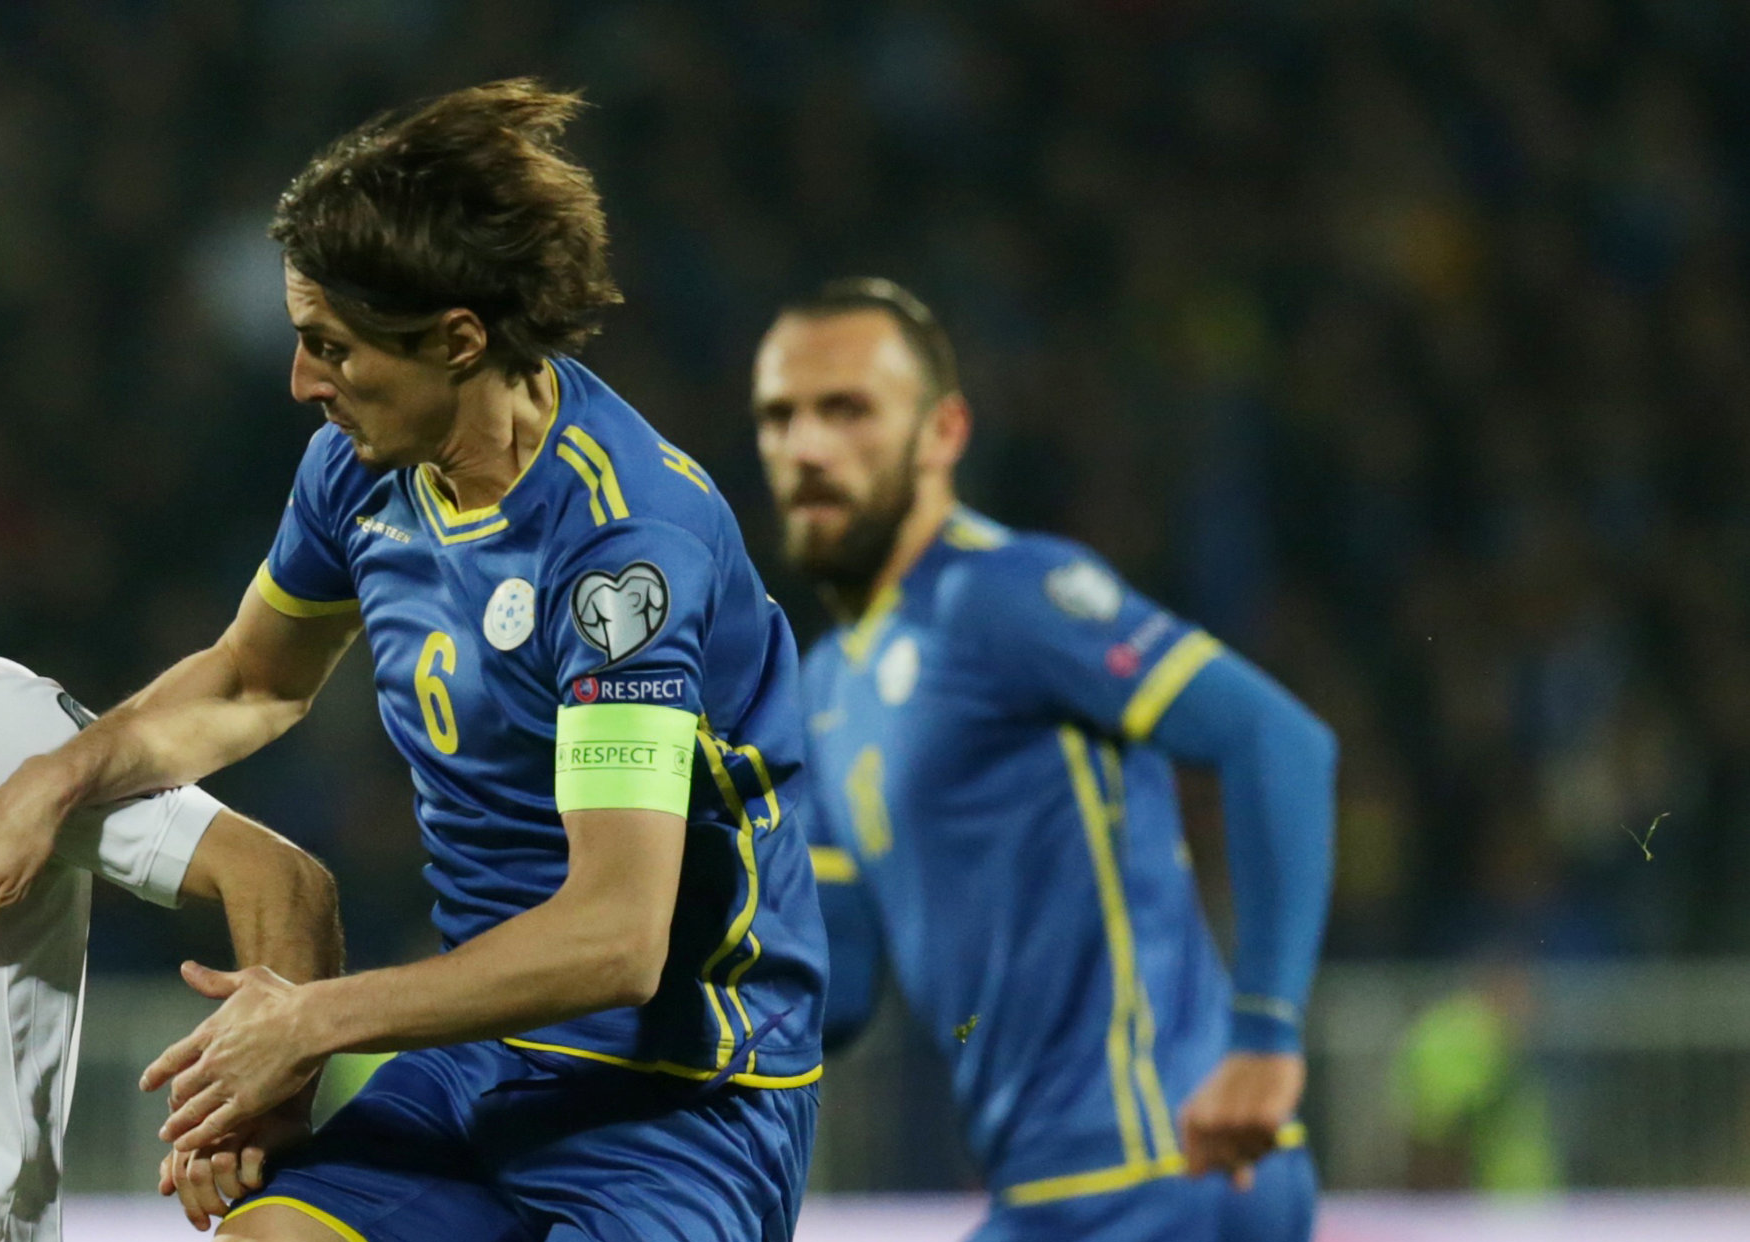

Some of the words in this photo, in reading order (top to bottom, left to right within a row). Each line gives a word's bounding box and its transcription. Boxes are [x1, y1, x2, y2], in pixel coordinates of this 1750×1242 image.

[414, 631, 458, 754] 6
[601, 679, 684, 700] RESPECT
[571, 747, 657, 765] RESPECT
